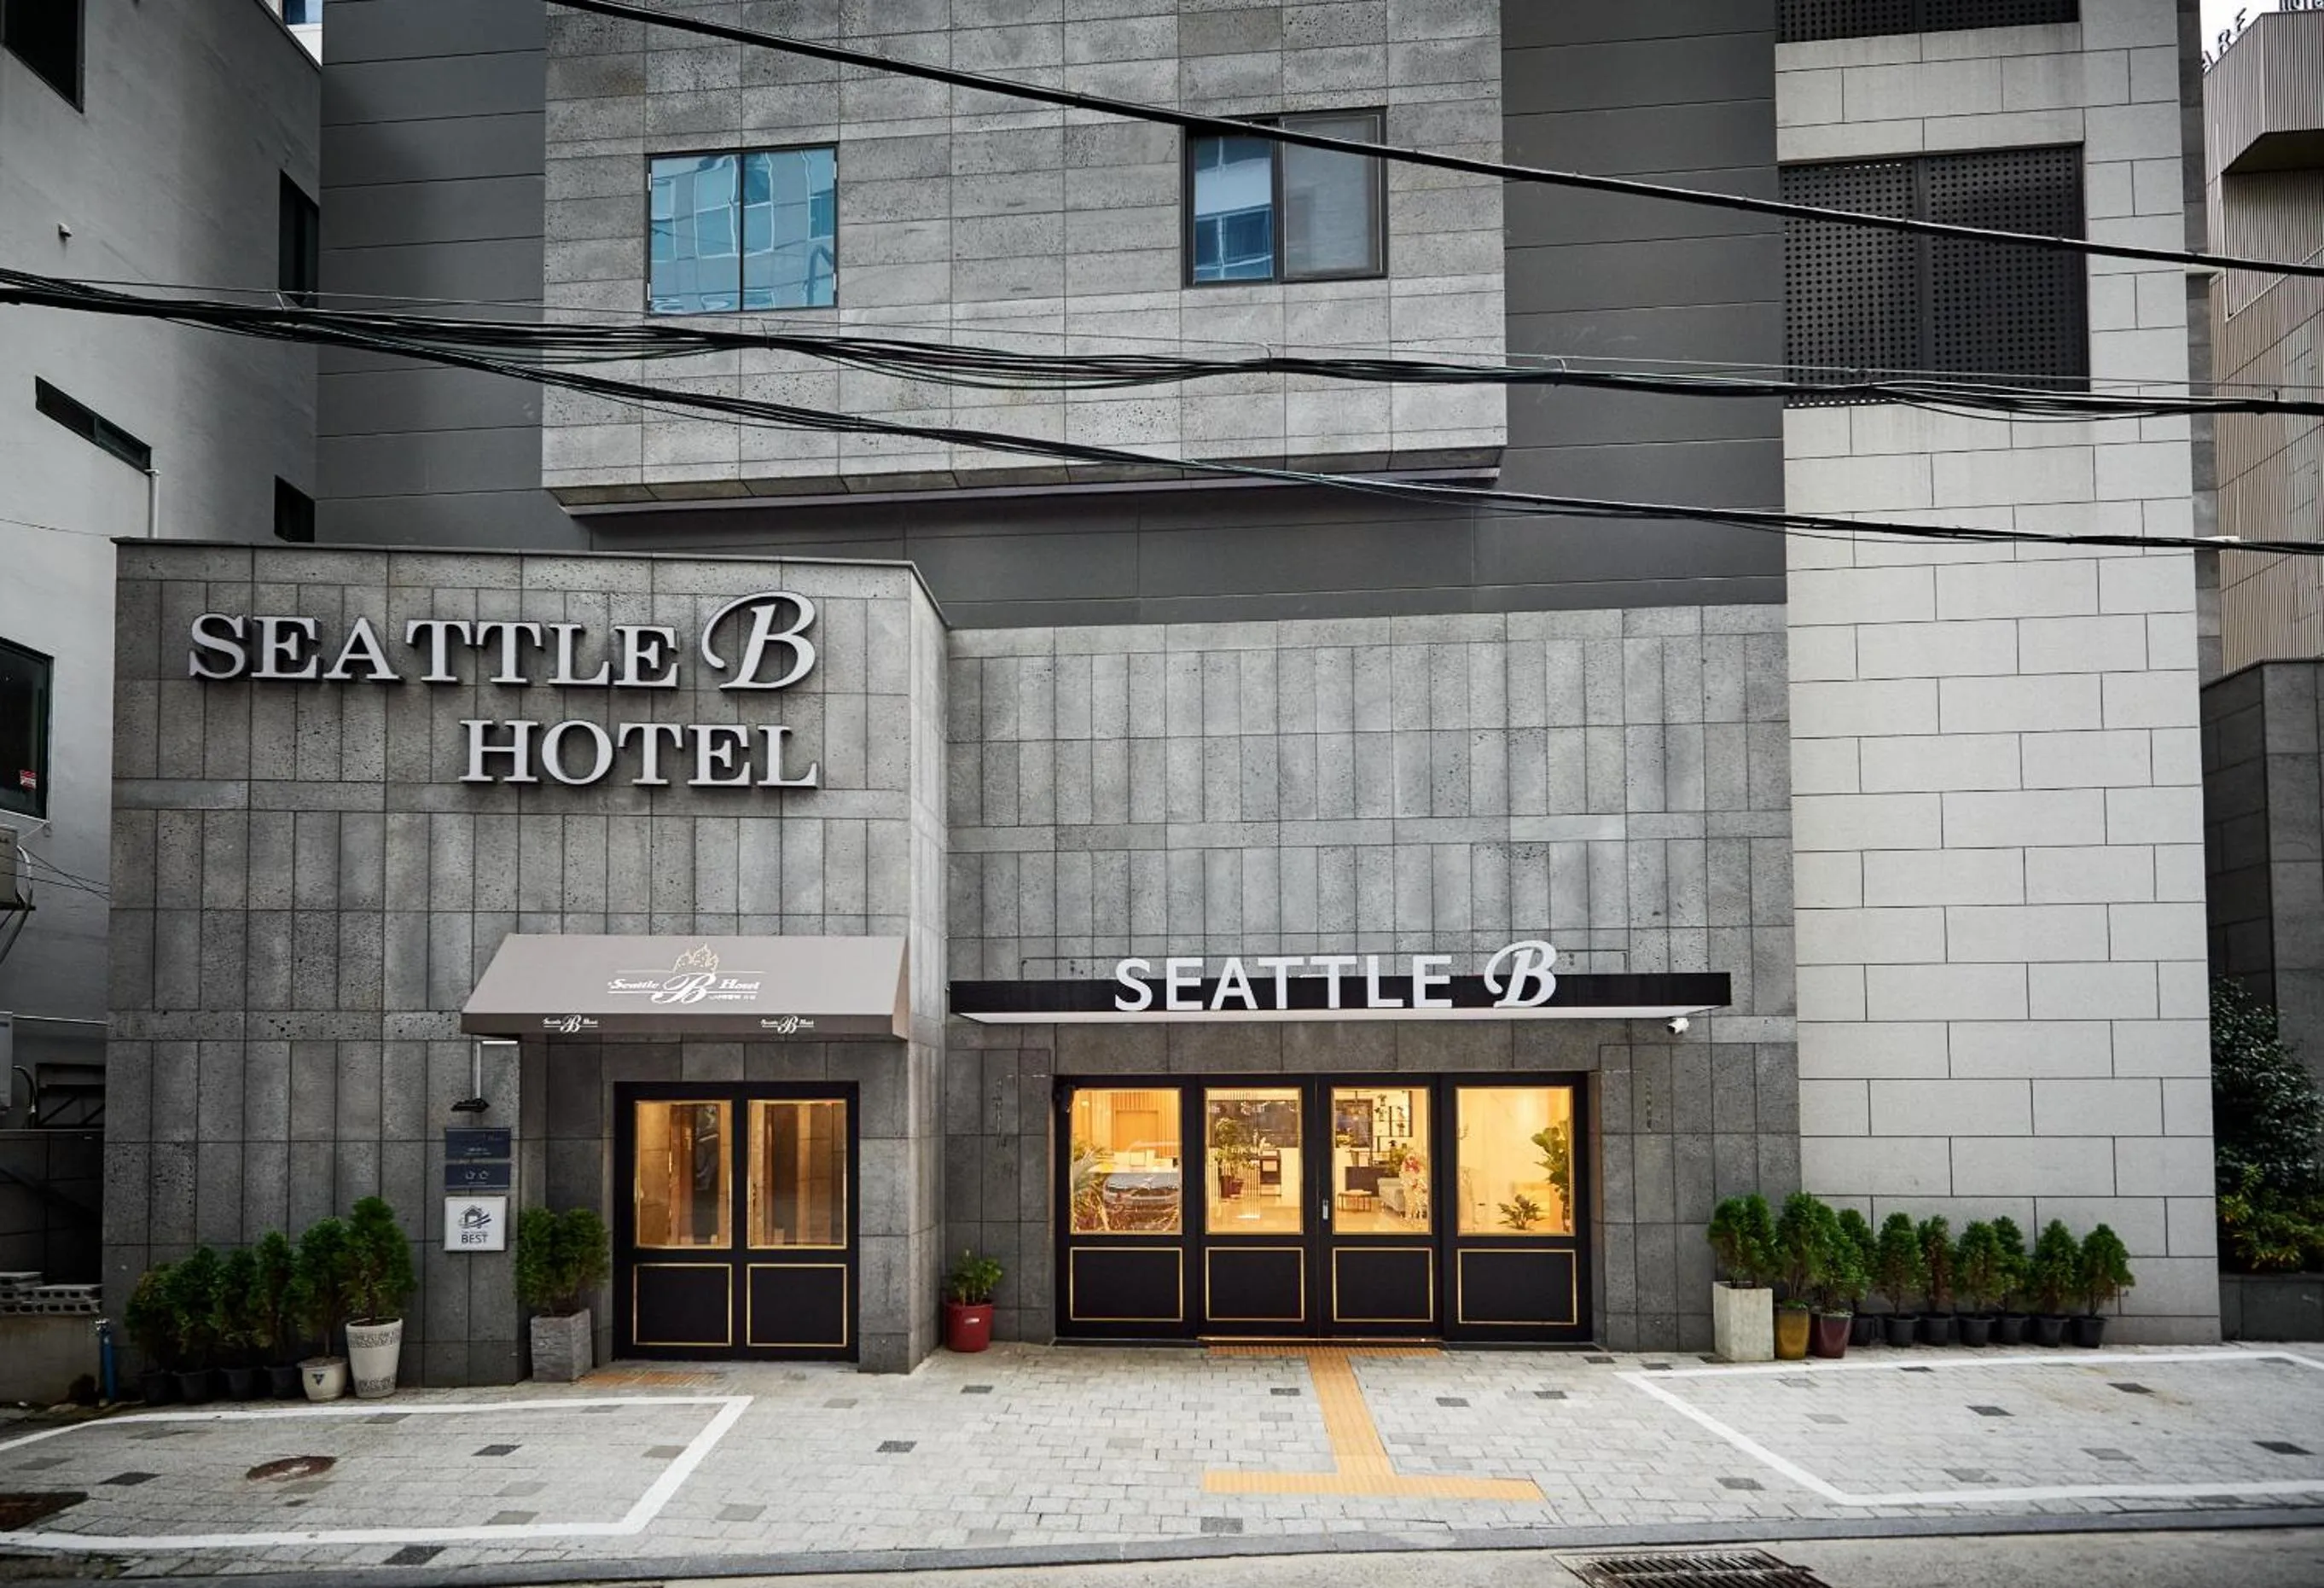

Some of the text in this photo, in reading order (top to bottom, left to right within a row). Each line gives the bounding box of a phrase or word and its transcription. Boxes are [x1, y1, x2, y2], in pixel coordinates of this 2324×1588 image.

[189, 590, 816, 689] SEATTLE B
[458, 719, 819, 788] HOTEL
[651, 972, 717, 1004] B
[1114, 939, 1557, 1011] SEATTLE B
[461, 1234, 489, 1244] BEST
